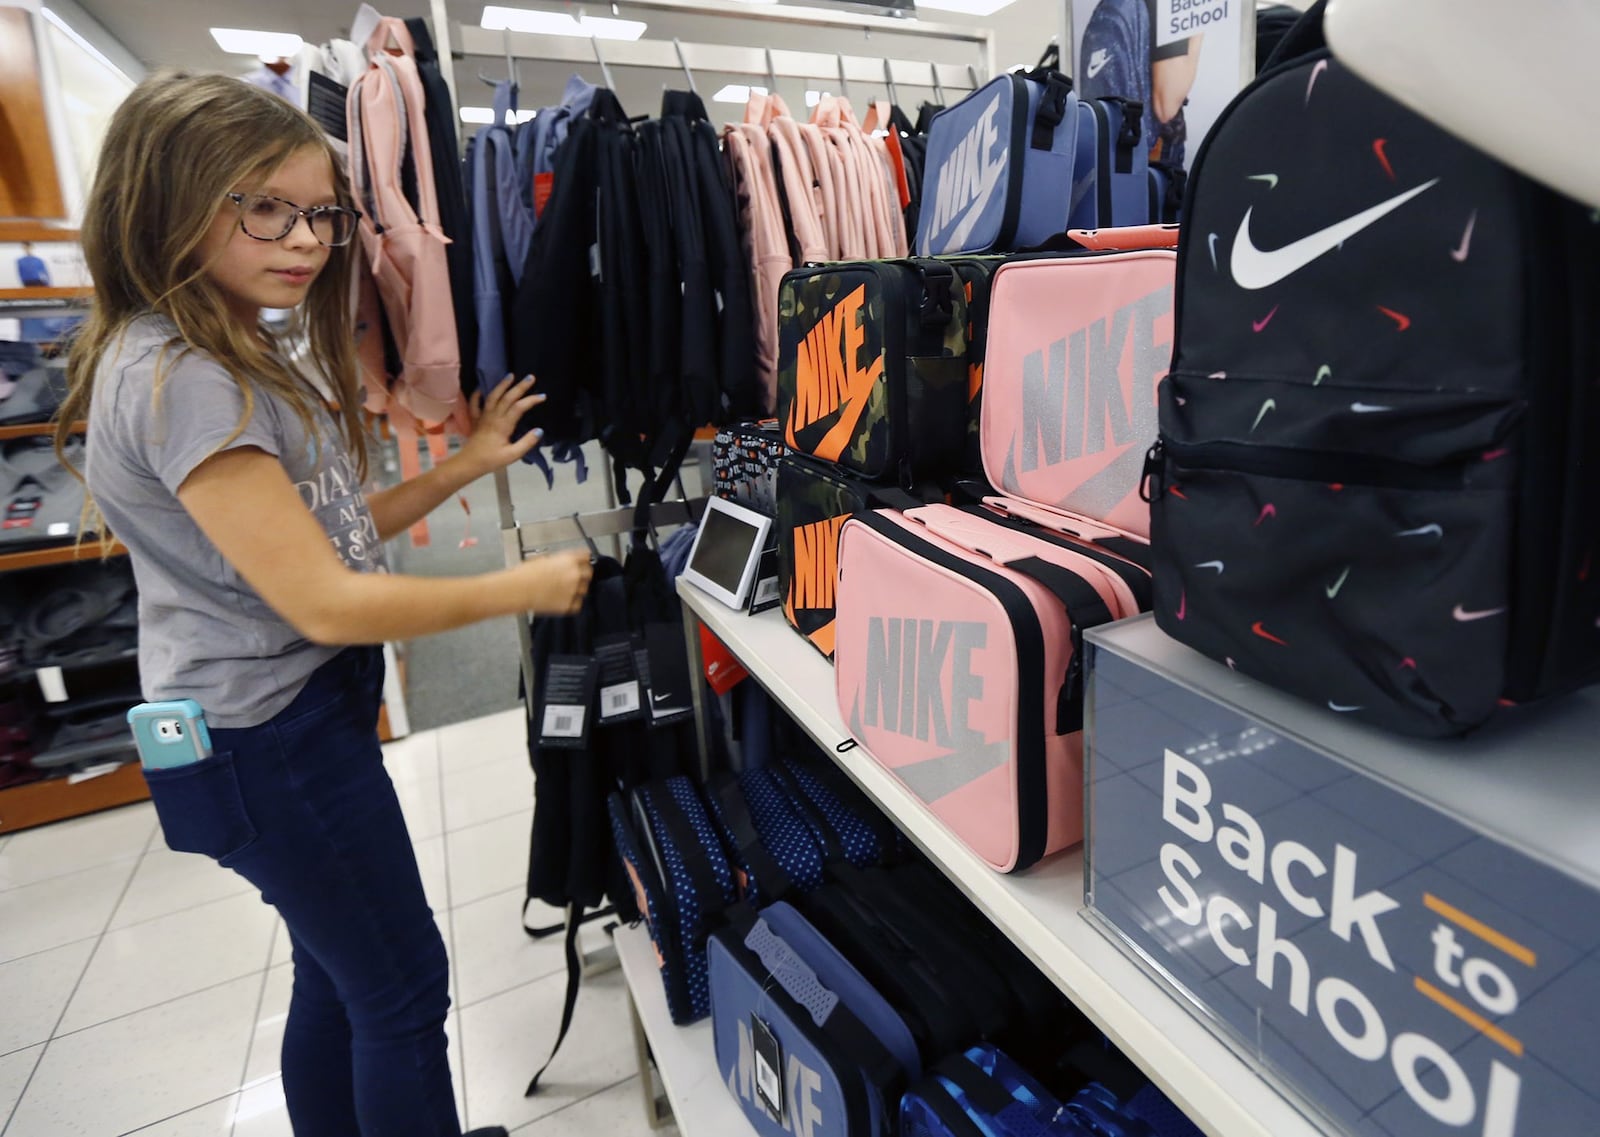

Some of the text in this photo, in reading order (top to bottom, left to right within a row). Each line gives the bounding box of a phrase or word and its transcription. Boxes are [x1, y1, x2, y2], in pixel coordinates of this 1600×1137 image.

[1170, 1, 1228, 34] School
[931, 92, 1000, 241] NIKE
[794, 282, 866, 433] NIKE
[1021, 282, 1172, 474] NIKE
[794, 513, 852, 610] NIK
[864, 616, 988, 751] NIKE
[1163, 748, 1518, 1015] Back to
[1157, 843, 1521, 1137] School
[738, 1018, 822, 1137] NKE
